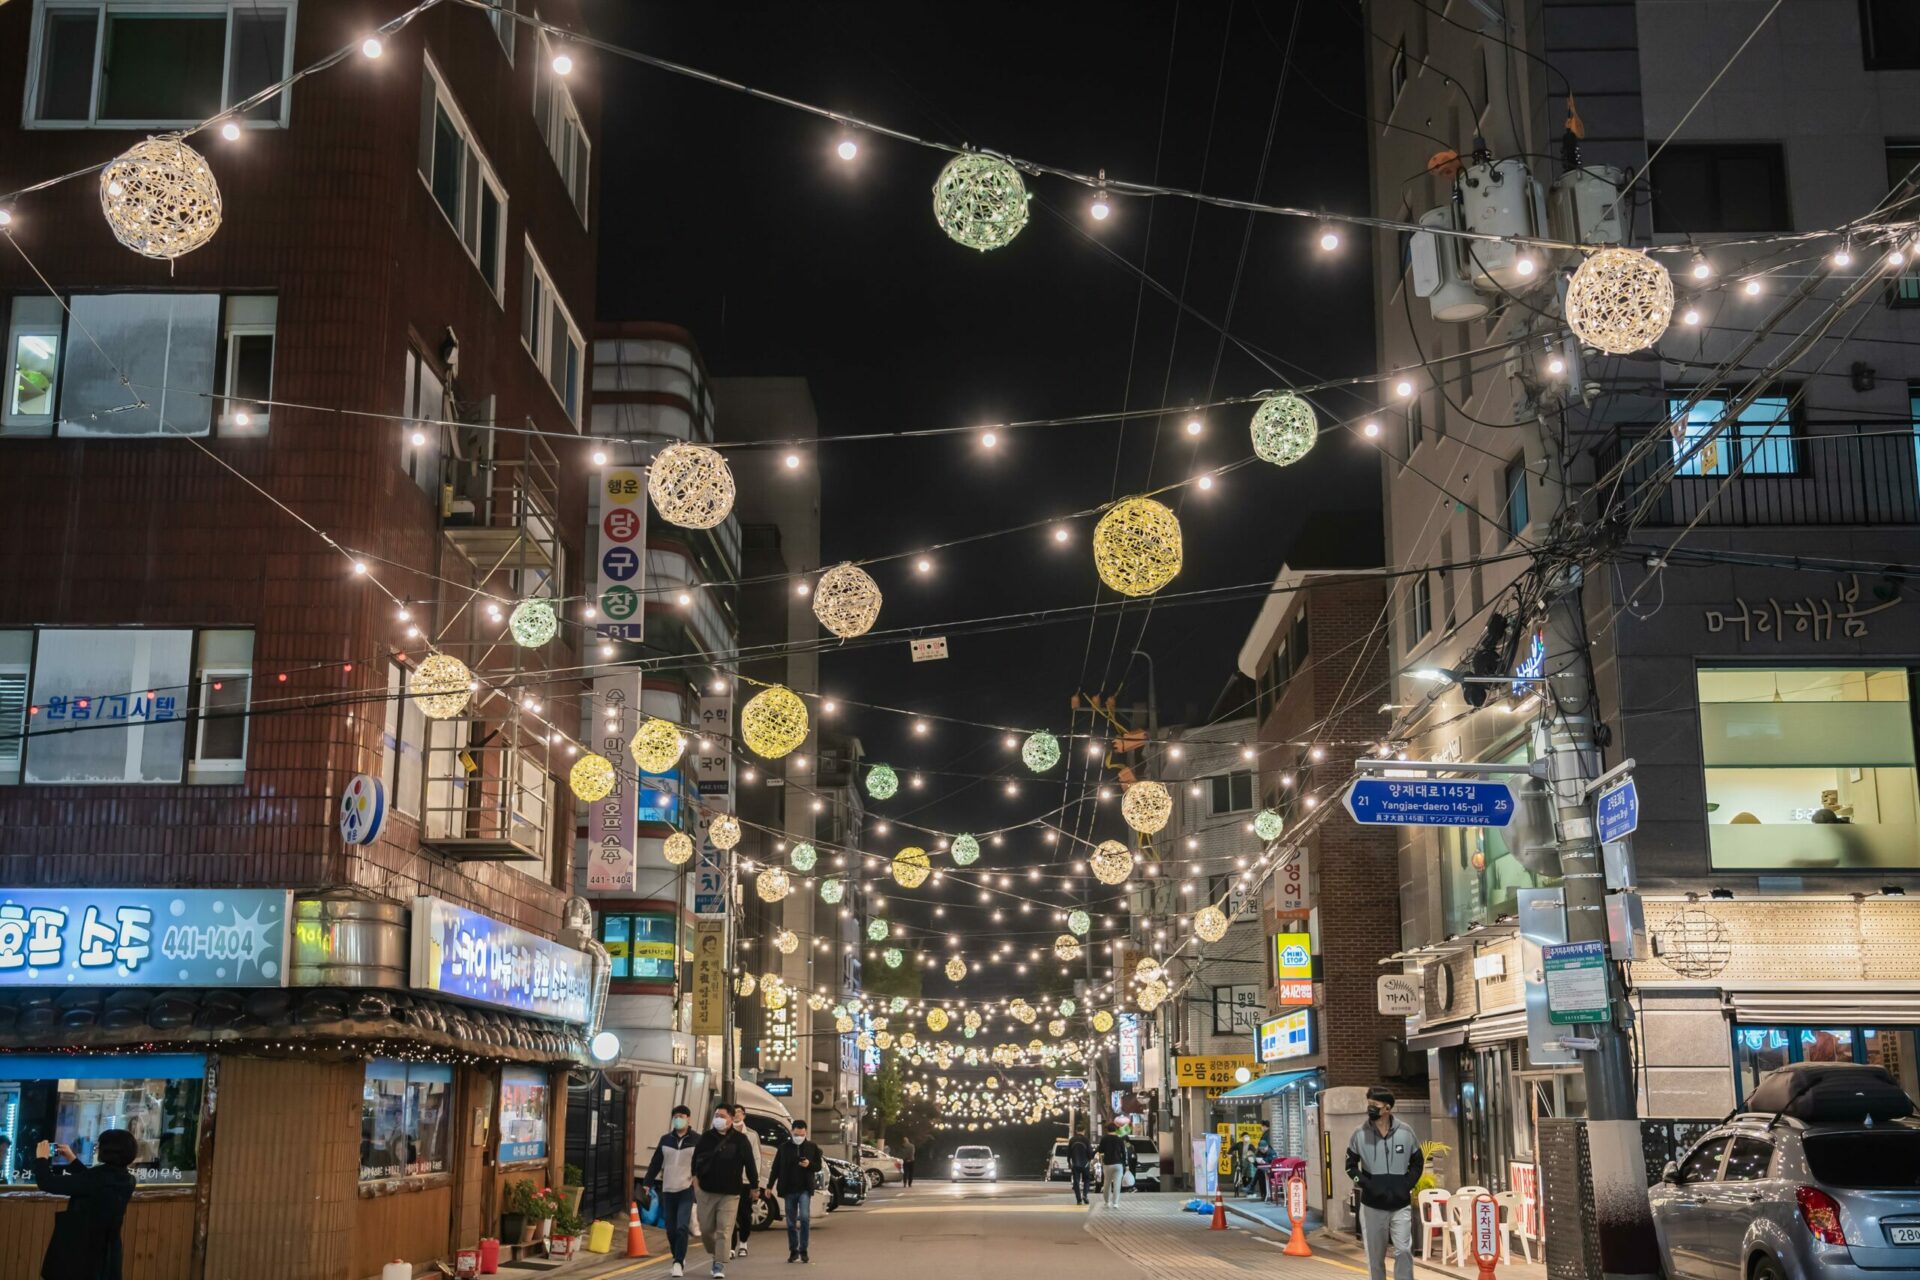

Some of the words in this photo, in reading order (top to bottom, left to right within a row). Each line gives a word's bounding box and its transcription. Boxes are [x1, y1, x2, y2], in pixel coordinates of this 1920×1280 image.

[608, 479, 638, 494] 행운
[607, 512, 636, 617] 당구장
[1706, 573, 1902, 642] 머리해봄
[703, 709, 727, 723] 수학
[702, 757, 726, 771] 국어
[1389, 783, 1476, 799] 양재대로145길
[1358, 796, 1369, 806] 21
[1382, 801, 1449, 814] Yangjae-daero
[1452, 802, 1483, 813] 145-gil
[1495, 800, 1507, 810] 25
[602, 803, 622, 831] 호프
[601, 834, 621, 865] 소주
[590, 876, 631, 884] 441-1404
[1284, 864, 1301, 899] 영어
[0, 904, 66, 968] 호프
[80, 904, 151, 970] 소주
[162, 925, 255, 960] 441-1404
[534, 948, 549, 998] 호프
[552, 957, 567, 1005] 소주
[1280, 984, 1312, 999] 24시간영업
[1386, 994, 1409, 1003] 까시
[772, 990, 787, 1055] 제맥주
[1182, 1063, 1206, 1080] 으뜸
[1480, 1205, 1492, 1251] 주차금지
